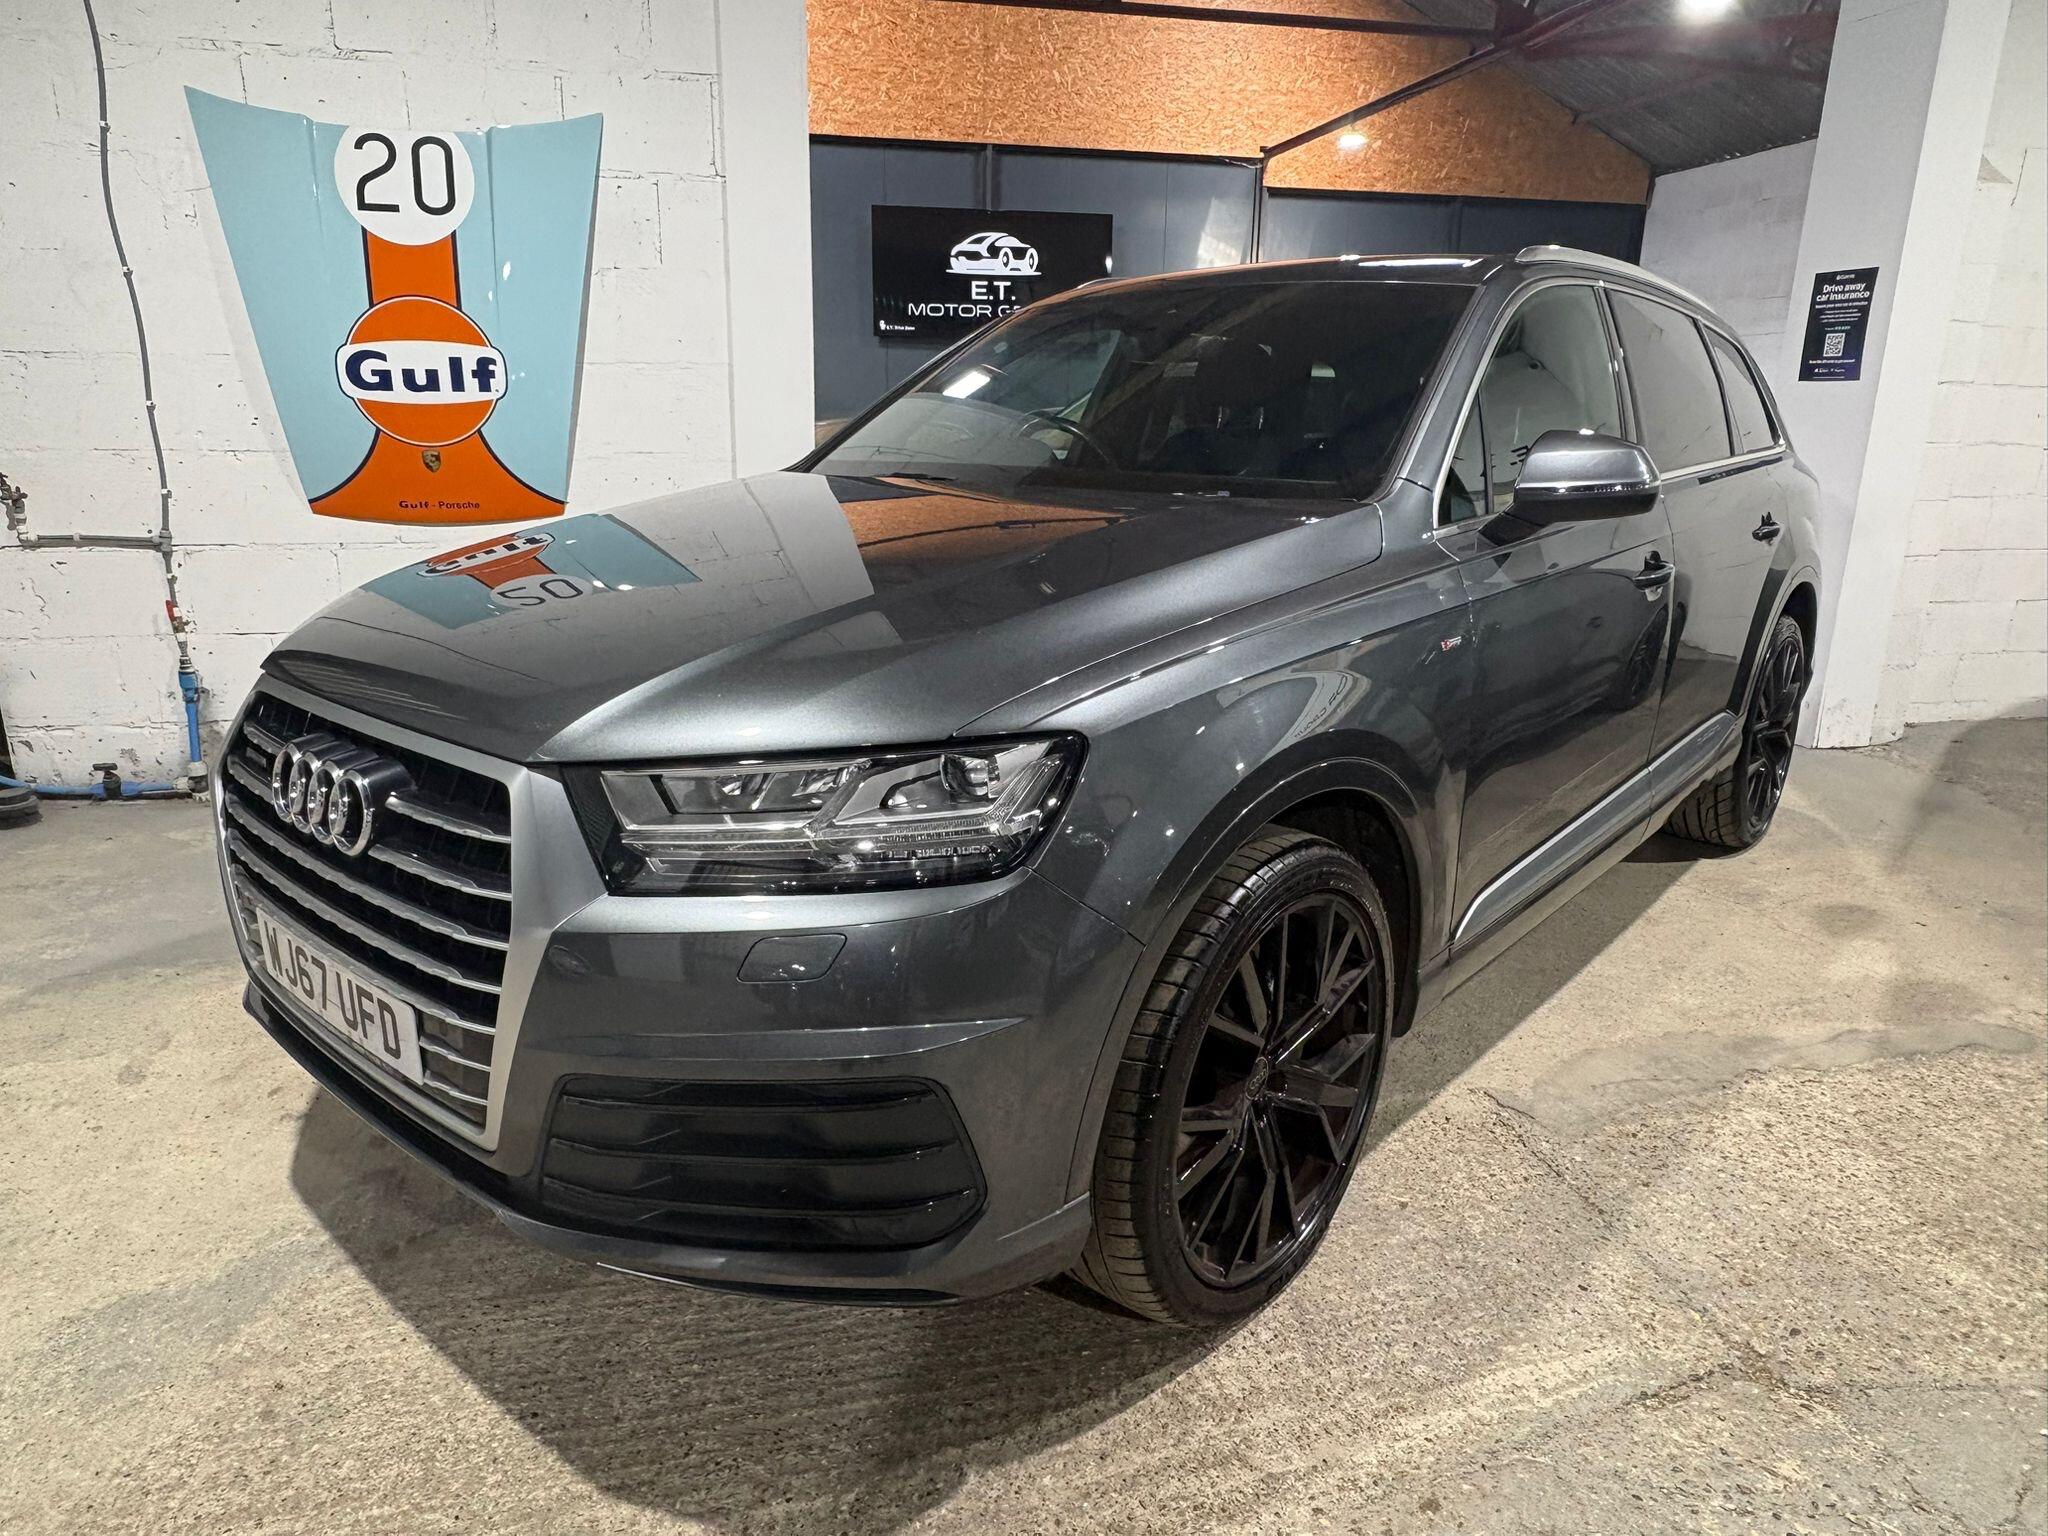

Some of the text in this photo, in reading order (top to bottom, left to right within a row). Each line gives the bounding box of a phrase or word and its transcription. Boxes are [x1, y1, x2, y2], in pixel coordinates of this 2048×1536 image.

[353, 132, 458, 215] 20
[970, 280, 1017, 300] E.T.
[1823, 282, 1867, 293] Drive away
[1830, 291, 1870, 301] insurance
[908, 303, 992, 318] MOTOR
[344, 348, 498, 394] Gulf
[399, 500, 429, 509] Gulf
[438, 501, 480, 509] Porsche
[263, 920, 402, 1060] WJ67 UFD
